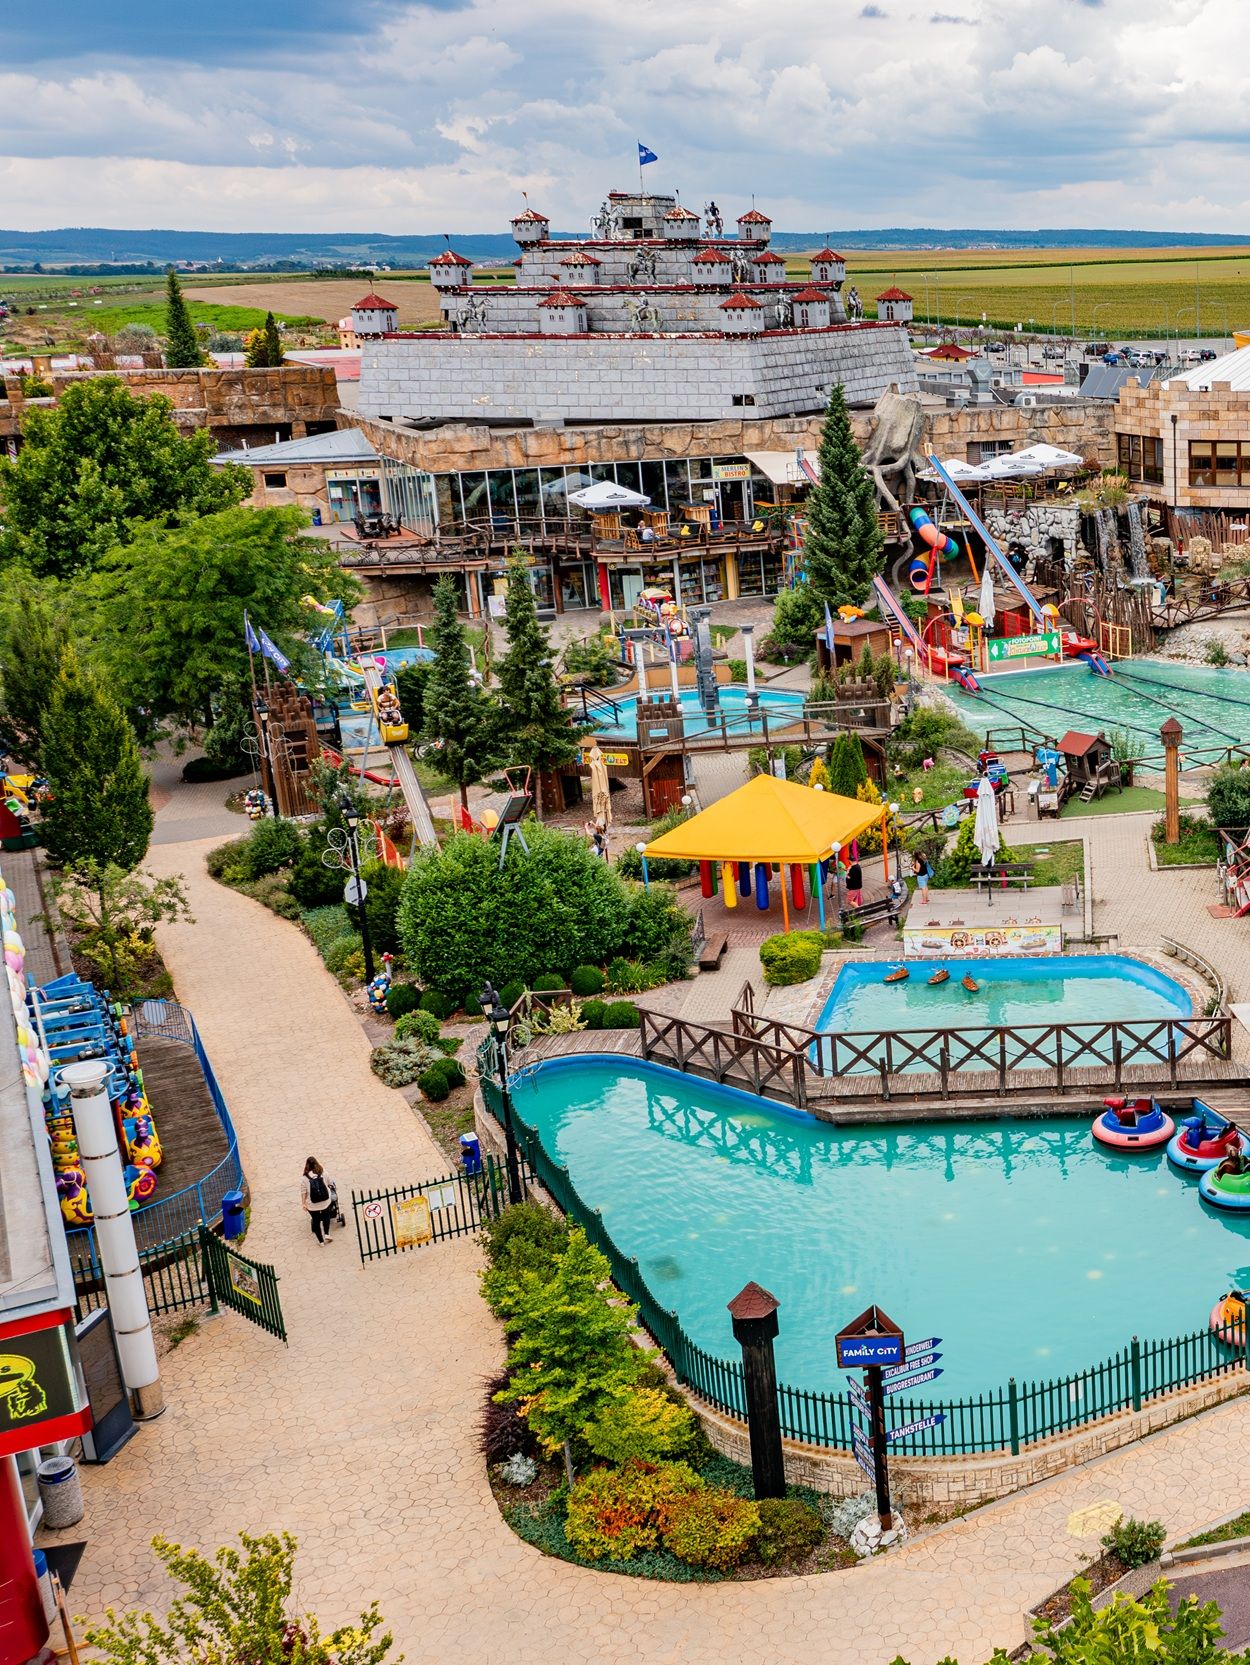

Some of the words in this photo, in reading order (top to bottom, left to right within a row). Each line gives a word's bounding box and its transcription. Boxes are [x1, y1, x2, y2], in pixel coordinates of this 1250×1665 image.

[885, 1362, 909, 1379] EXCALIBUR
[909, 1359, 921, 1370] FREE
[920, 1355, 934, 1368] SHOP
[886, 1370, 935, 1394] BURGRESTAURANT
[890, 1417, 936, 1440] TANKSTELLE
